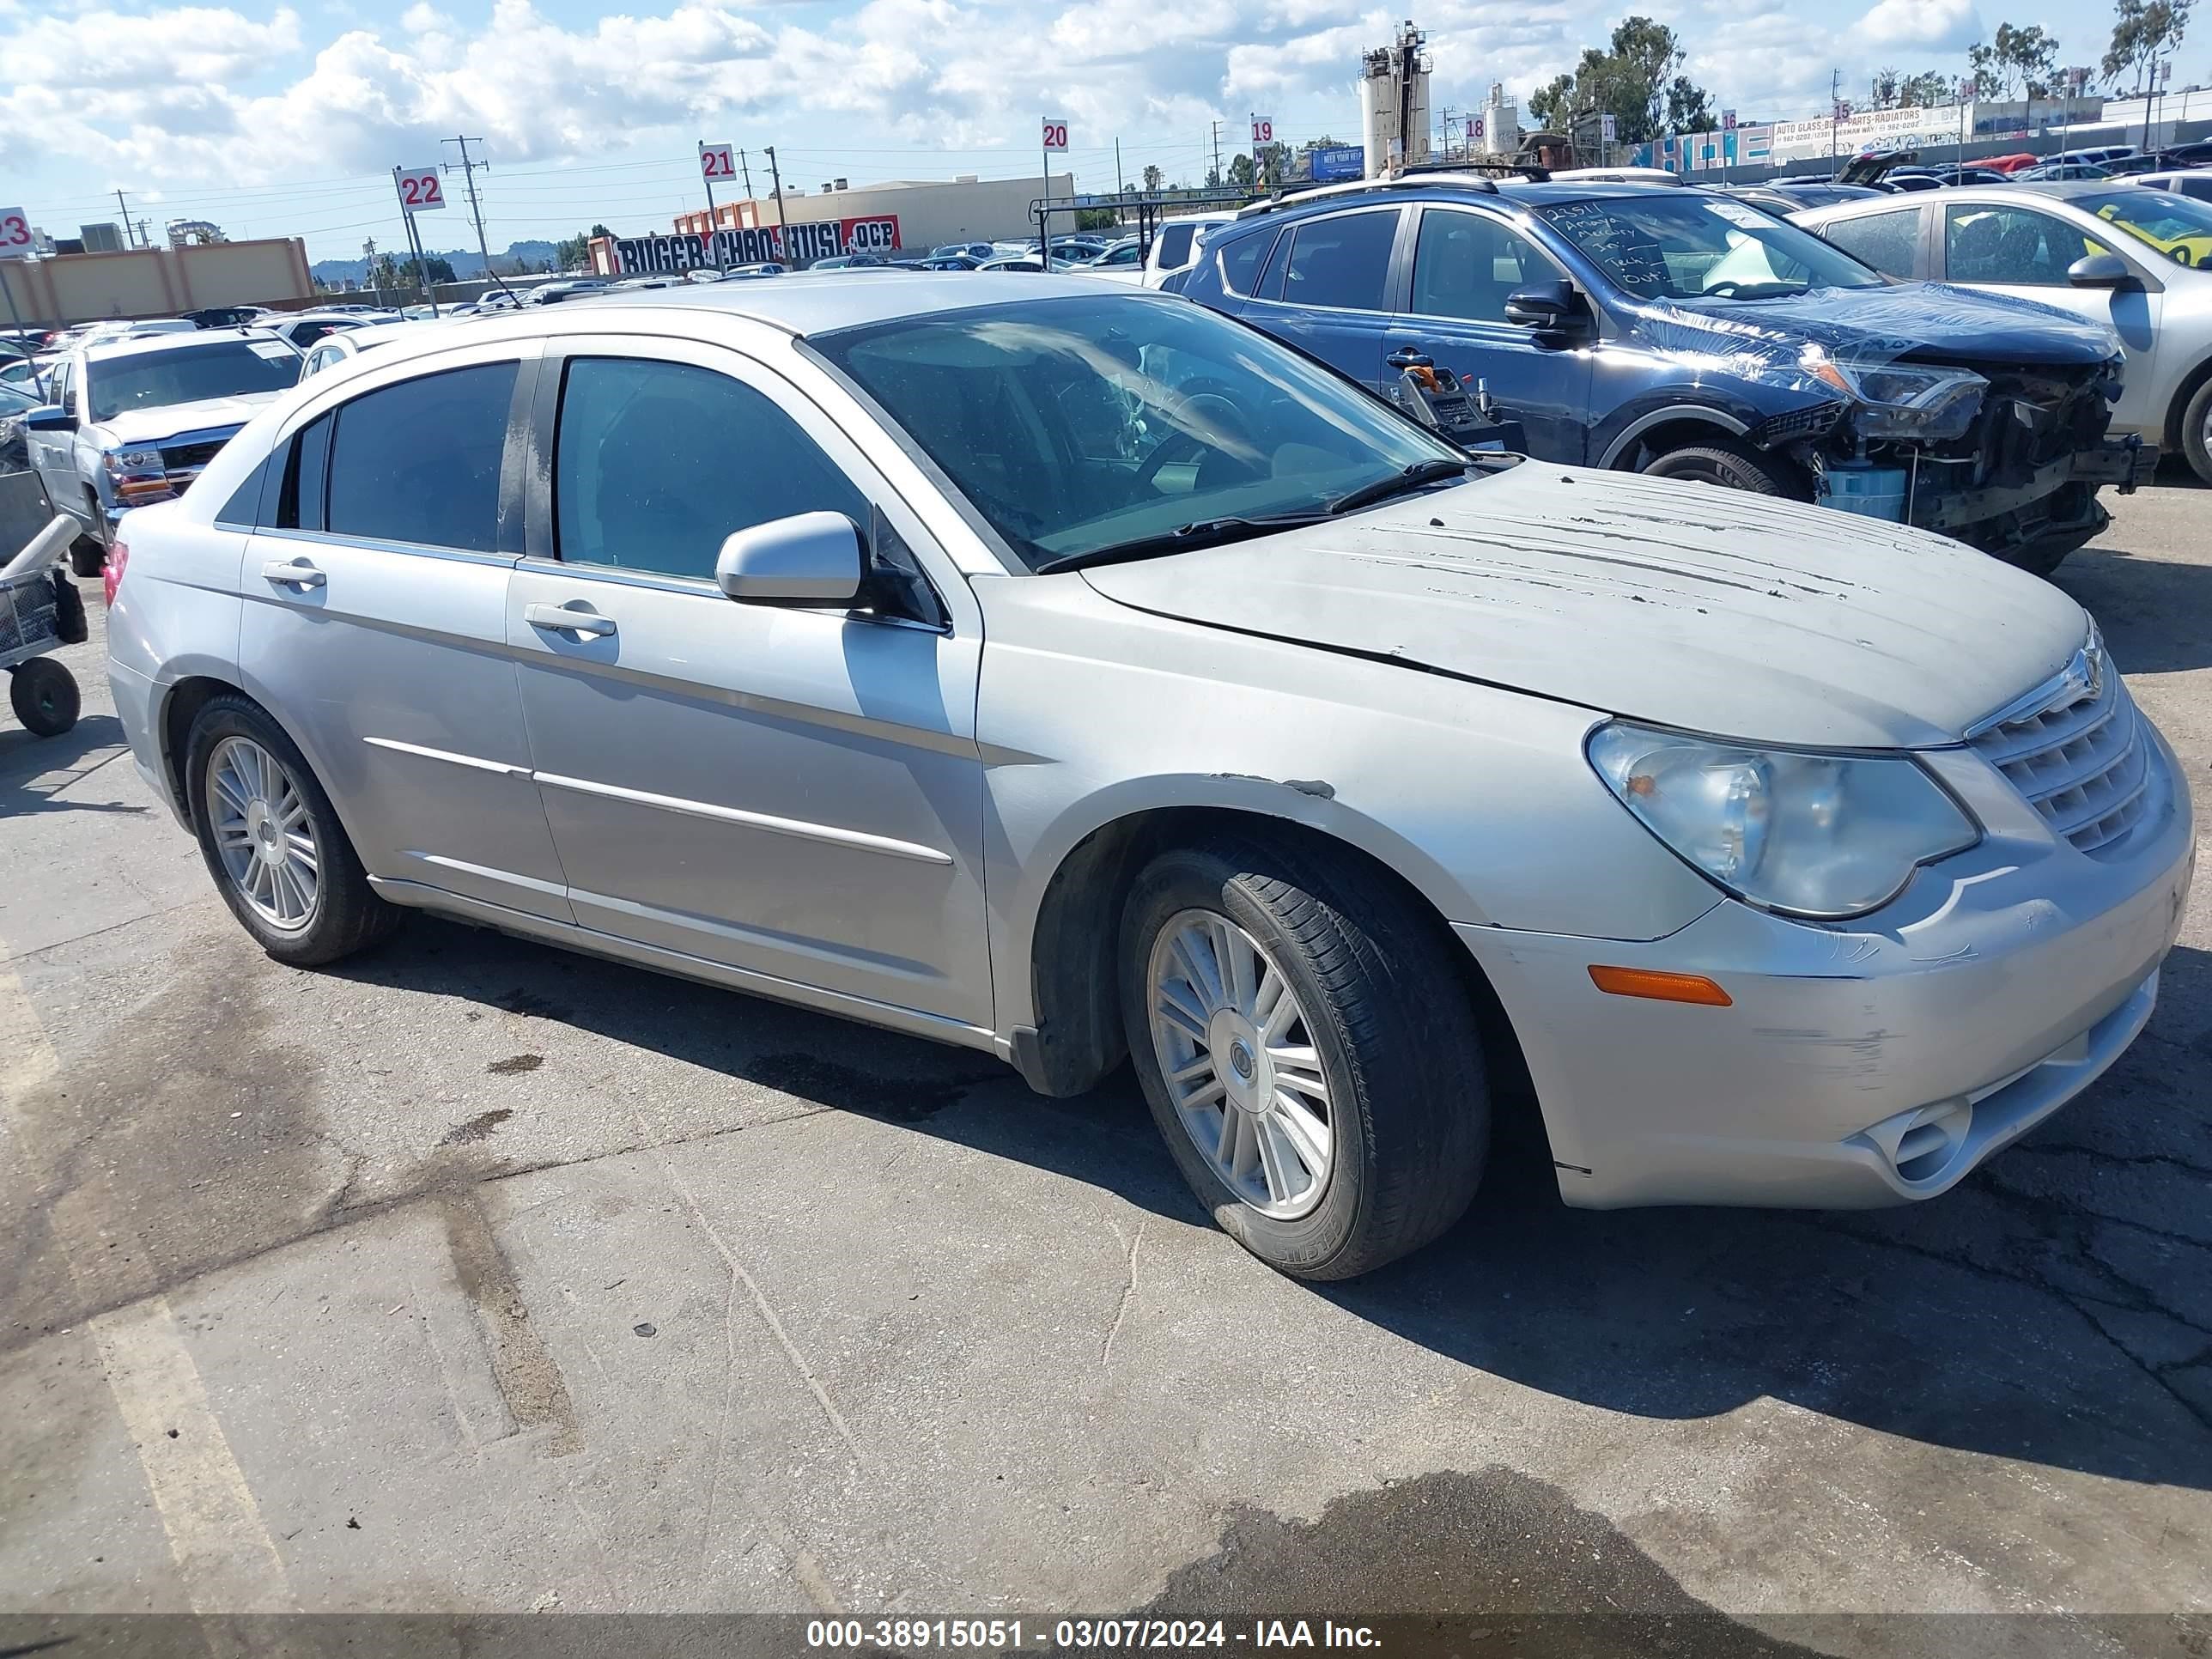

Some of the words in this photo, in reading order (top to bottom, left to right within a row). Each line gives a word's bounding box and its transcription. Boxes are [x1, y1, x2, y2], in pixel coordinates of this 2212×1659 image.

[2069, 70, 2080, 83] 13
[1962, 84, 1973, 98] 14
[1834, 104, 1849, 120] 15
[1466, 119, 1484, 137] 18
[1603, 119, 1613, 137] 17
[1723, 114, 1736, 130] 16
[1777, 124, 1796, 136] AUTO
[1043, 125, 1066, 147] 20
[1252, 122, 1272, 142] 19
[1833, 127, 1860, 136] HERMAN
[702, 150, 734, 176] 21
[402, 176, 441, 204] 22
[1565, 216, 1622, 231] Amaya
[1578, 228, 1635, 239] Mercury
